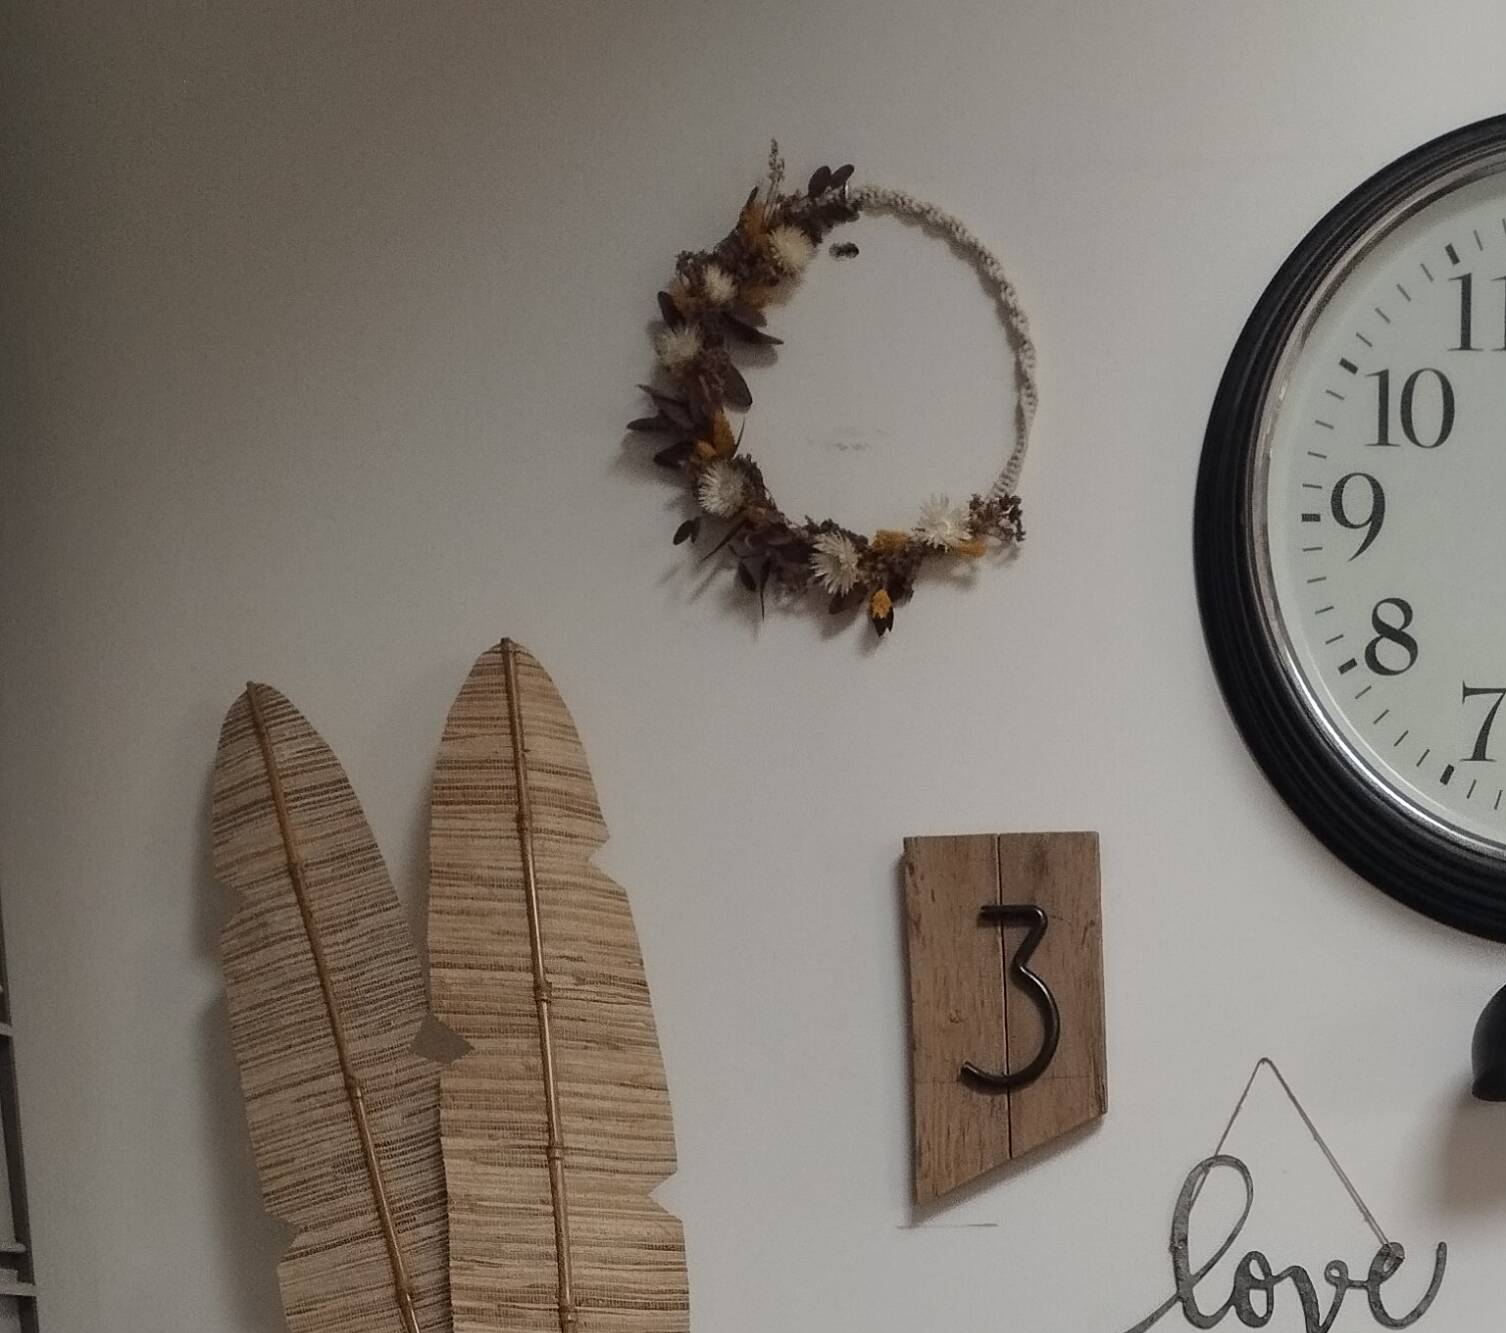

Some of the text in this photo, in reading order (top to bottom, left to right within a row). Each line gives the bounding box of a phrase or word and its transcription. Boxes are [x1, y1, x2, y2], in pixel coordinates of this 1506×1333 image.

[1365, 367, 1456, 450] 10
[1329, 471, 1386, 562] 9
[1363, 597, 1420, 677] 8
[960, 904, 1061, 1091] 3
